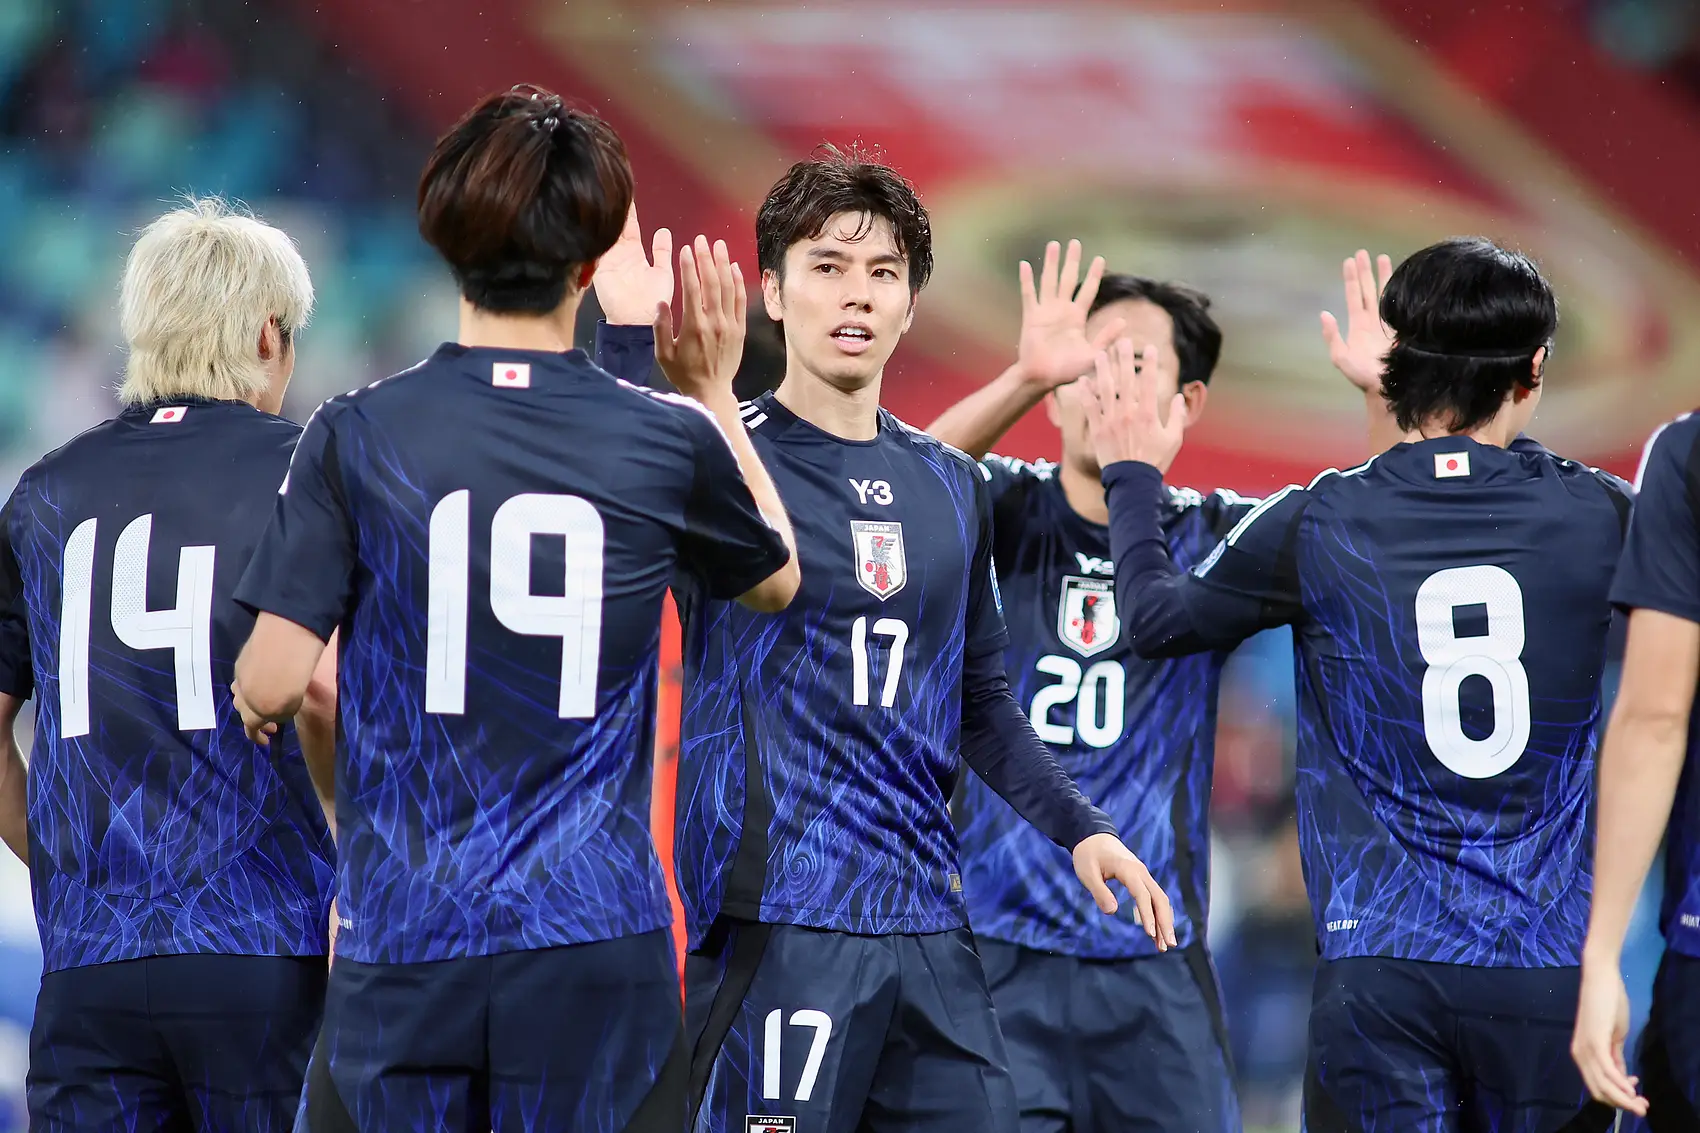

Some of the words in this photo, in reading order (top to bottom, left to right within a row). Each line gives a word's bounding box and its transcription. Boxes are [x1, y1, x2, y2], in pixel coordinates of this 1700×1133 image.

[848, 478, 894, 506] Y-3
[864, 524, 890, 532] JAPAN
[58, 513, 217, 739] 14
[425, 489, 605, 719] 19
[850, 616, 909, 708] 17
[1029, 655, 1125, 748] 20
[1415, 564, 1531, 779] 8
[763, 1008, 833, 1102] 17
